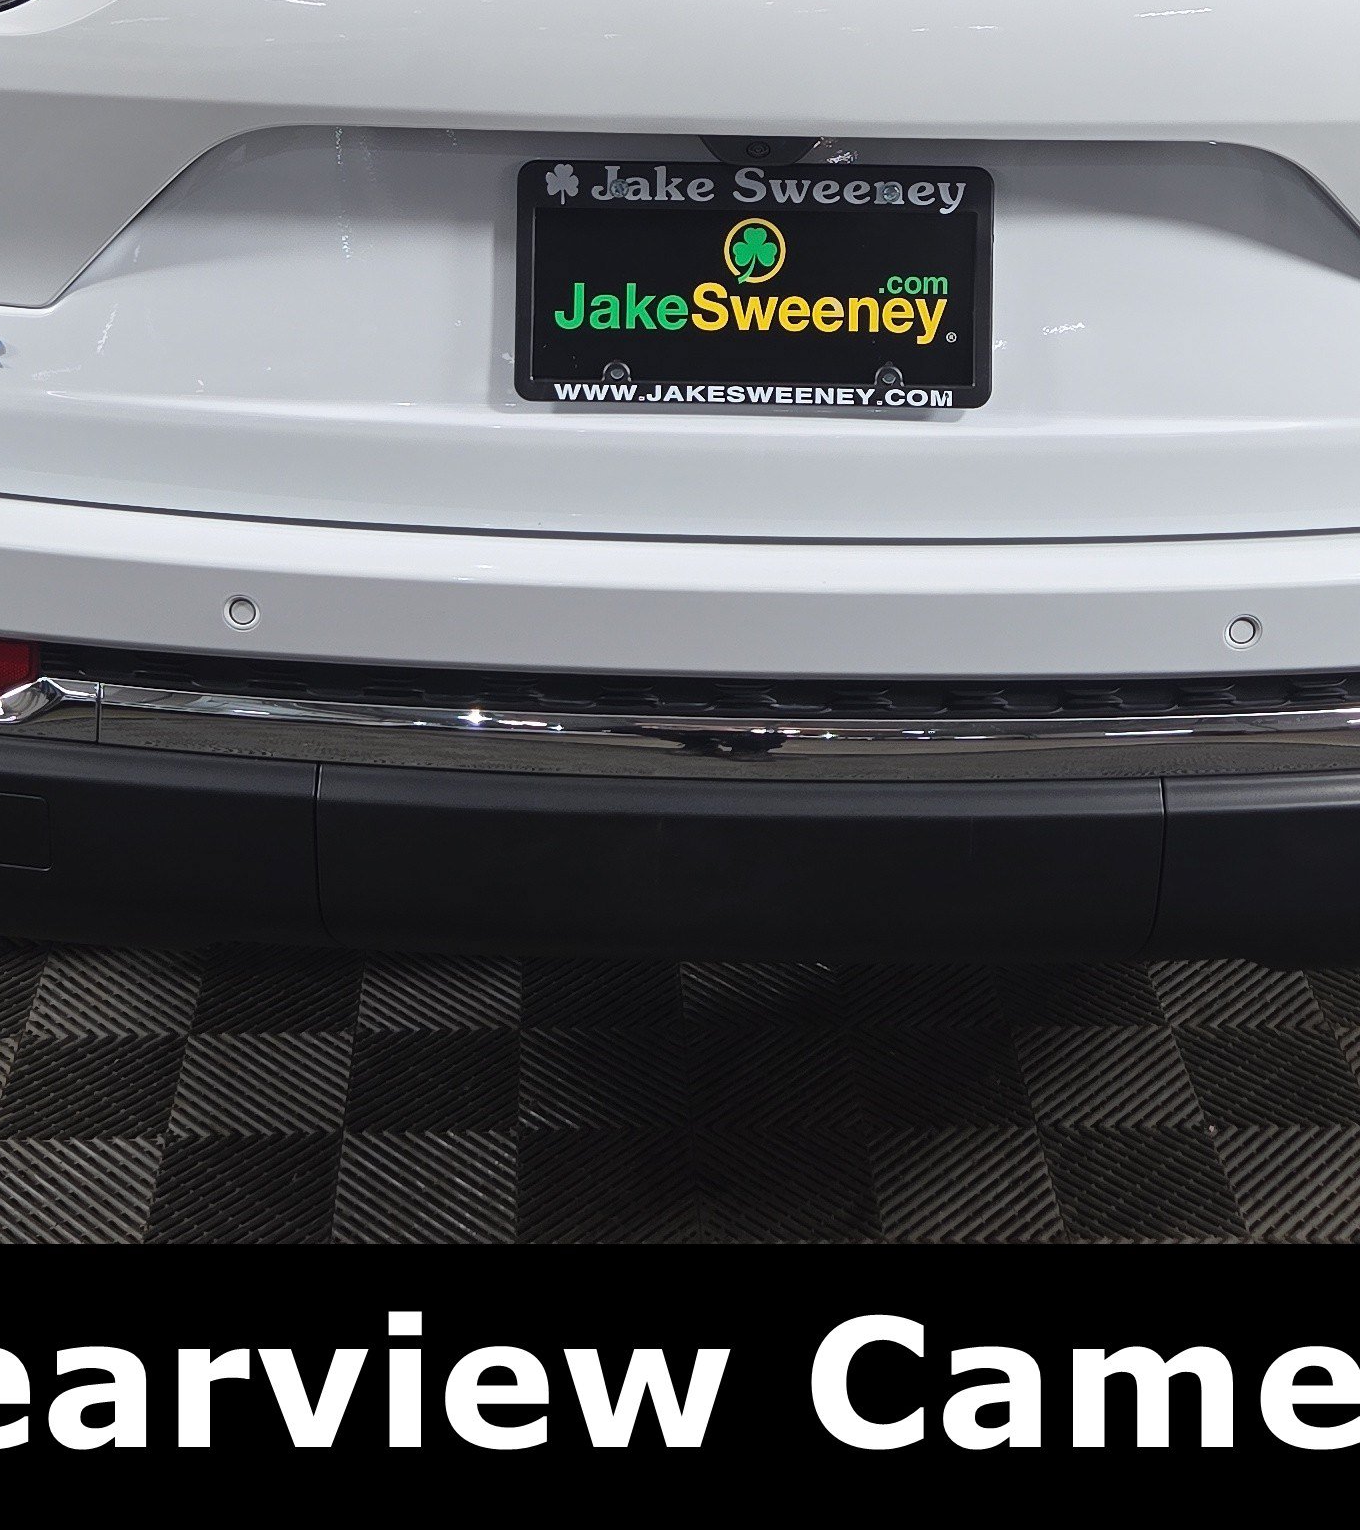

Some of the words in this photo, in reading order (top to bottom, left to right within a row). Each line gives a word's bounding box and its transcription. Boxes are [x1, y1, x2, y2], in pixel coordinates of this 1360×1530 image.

[591, 165, 716, 202] Jake
[733, 167, 967, 214] Sweeney
[554, 281, 948, 345] JakeSweeney
[554, 382, 954, 408] WWW.JAKESWEENEY.COM
